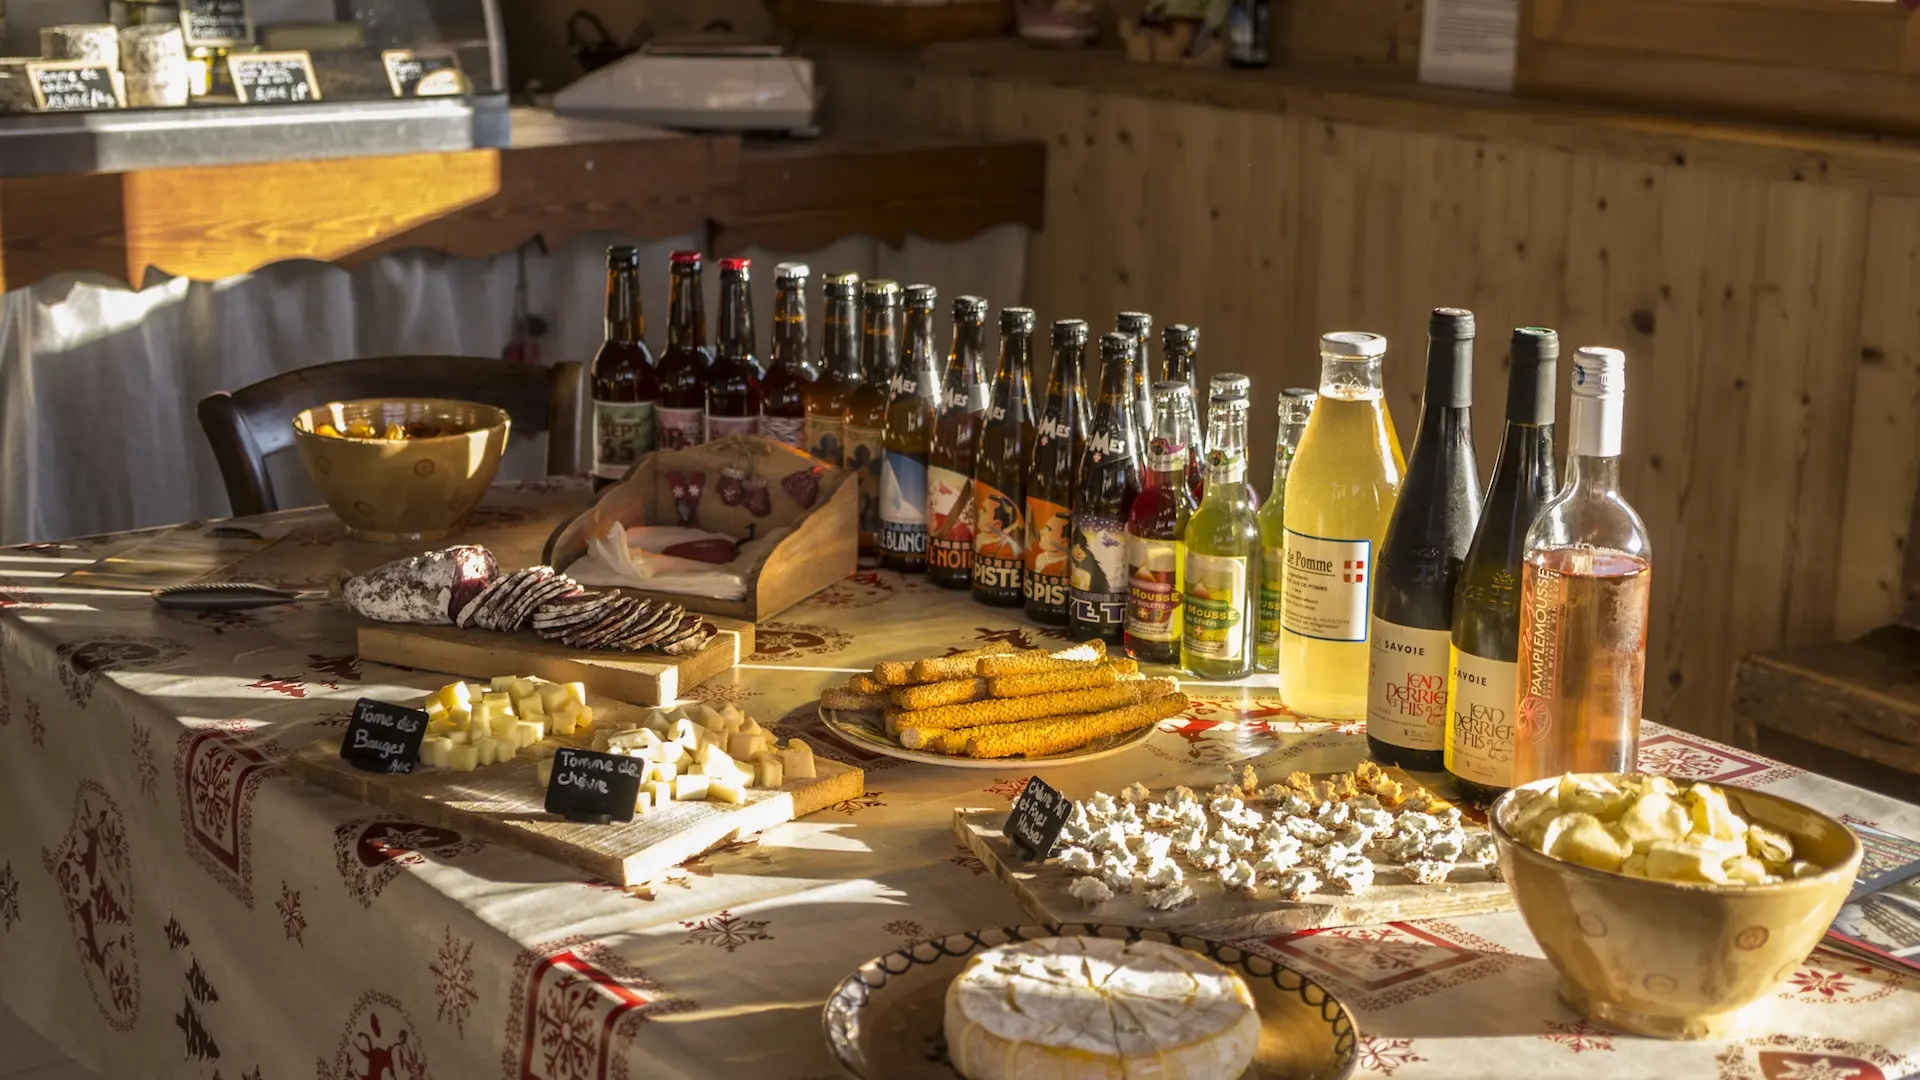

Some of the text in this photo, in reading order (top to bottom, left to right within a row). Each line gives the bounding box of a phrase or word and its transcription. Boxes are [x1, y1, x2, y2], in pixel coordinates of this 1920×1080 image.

[1296, 551, 1333, 573] Pomme
[973, 562, 1021, 588] PISTE
[1131, 586, 1181, 603] MOUSSE
[1188, 604, 1237, 621] MOUSSE
[1531, 568, 1551, 697] PAMPLEMOUSSE
[1385, 640, 1425, 656] SAVOIE
[1407, 672, 1443, 692] JEAN
[1453, 667, 1487, 687] SAVOIE
[1400, 700, 1425, 718] FILS
[1469, 703, 1505, 724] JEAN
[396, 715, 420, 734] des
[353, 728, 405, 759] Bauges
[1463, 731, 1486, 750] FILS
[560, 751, 641, 779] Tomme de
